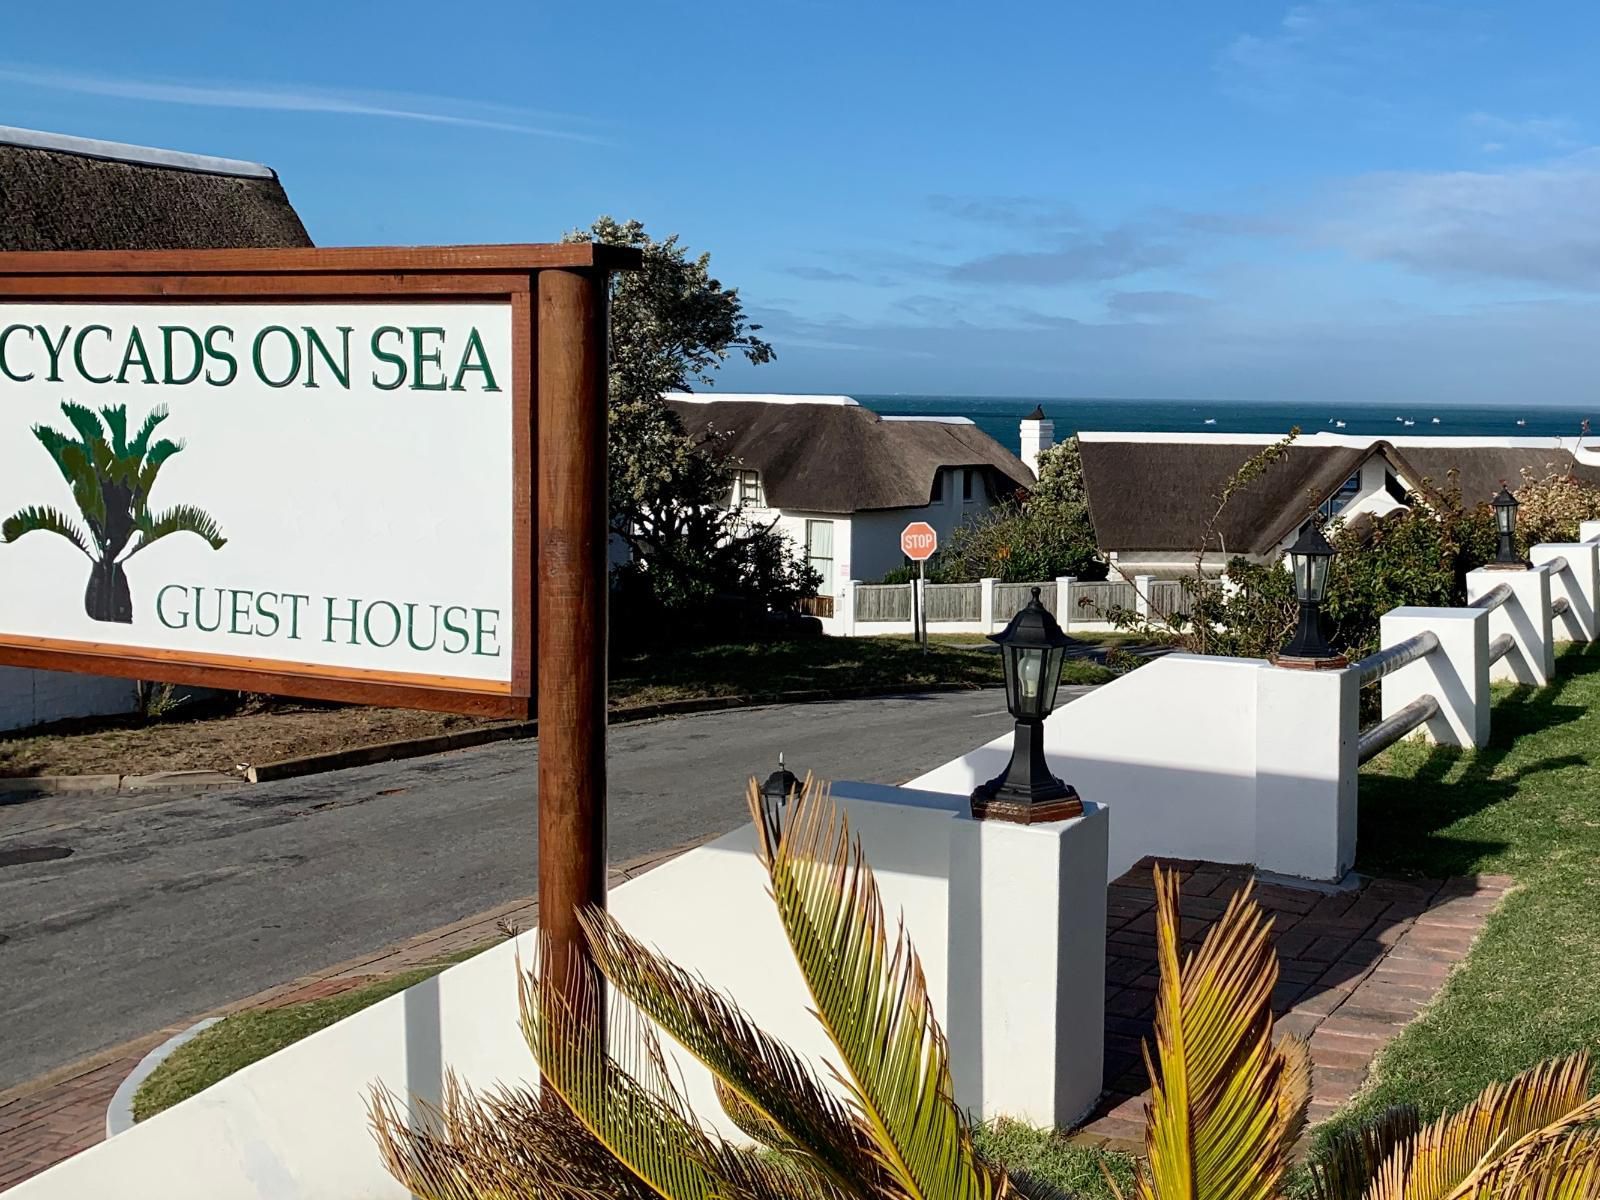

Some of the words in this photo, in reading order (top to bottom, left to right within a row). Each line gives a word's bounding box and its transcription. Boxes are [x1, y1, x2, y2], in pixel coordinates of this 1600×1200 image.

[0, 323, 238, 387] CYCADS
[252, 324, 355, 390] ON
[370, 325, 503, 393] SEA
[905, 533, 933, 549] STOP
[156, 584, 310, 640] GUEST
[321, 596, 502, 657] HOUSE
